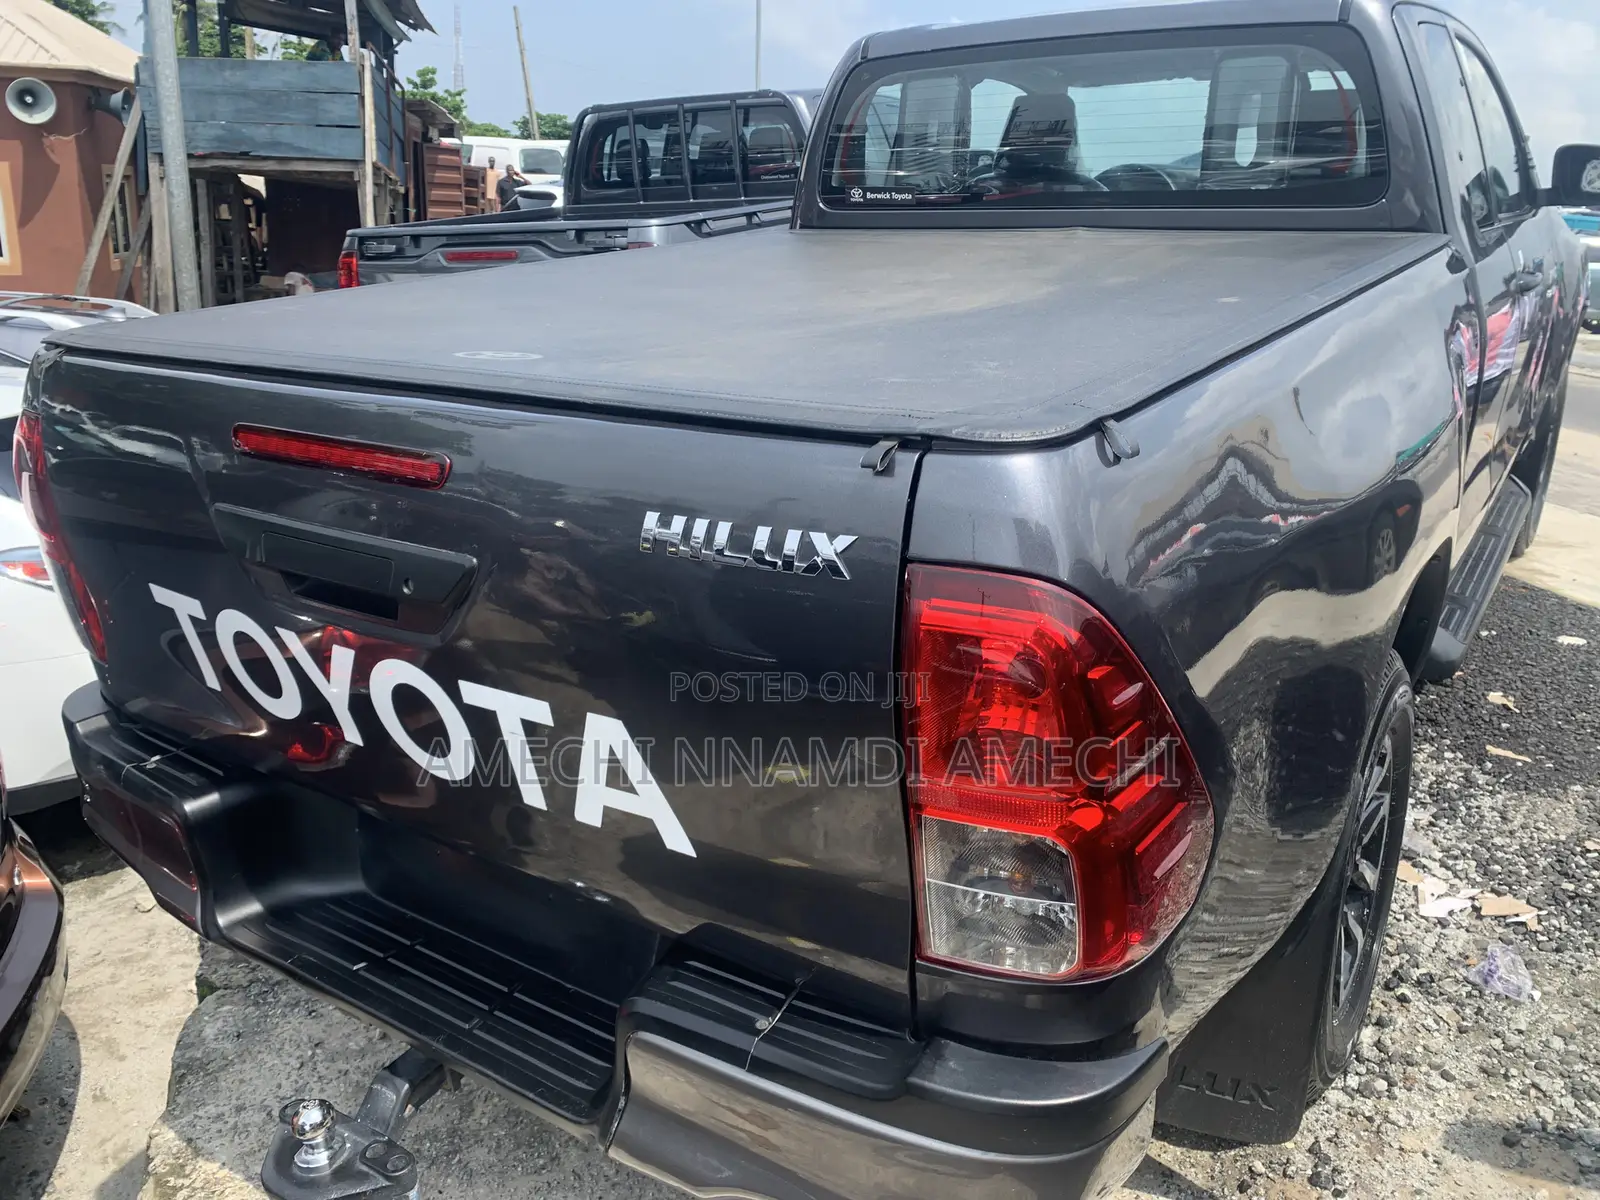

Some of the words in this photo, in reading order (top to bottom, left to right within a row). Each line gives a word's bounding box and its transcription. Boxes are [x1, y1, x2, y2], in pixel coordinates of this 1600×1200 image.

[892, 192, 912, 200] Toyota
[639, 511, 859, 581] HILUX
[148, 583, 697, 858] TOYOTA
